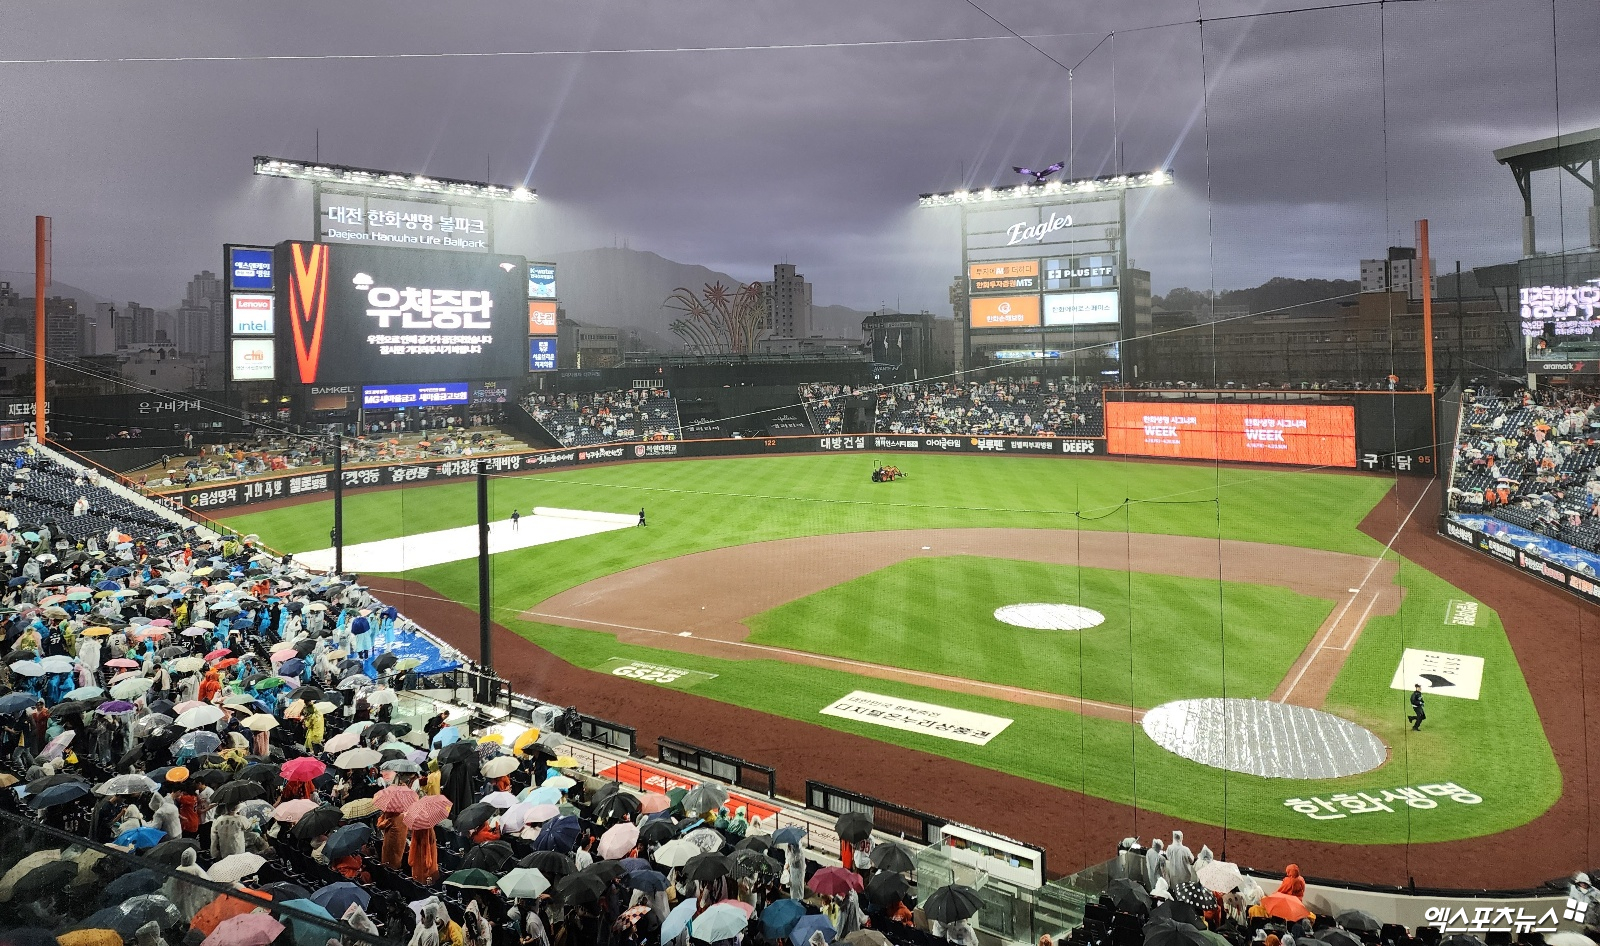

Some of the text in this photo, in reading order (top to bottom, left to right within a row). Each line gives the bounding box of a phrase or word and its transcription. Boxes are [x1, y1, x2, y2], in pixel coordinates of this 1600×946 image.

[328, 206, 485, 234] 대전 한화생명 볼파크
[1007, 212, 1072, 246] Eagles
[328, 229, 485, 249] Daejeon Hanwha Life Ballpark
[1064, 267, 1112, 277] PLUS ETF
[238, 299, 268, 308] Lenovo
[366, 287, 493, 329] 우천중단
[239, 320, 267, 331] intel
[1543, 362, 1574, 370] aramark
[311, 386, 354, 395] BAMKEL
[24, 420, 50, 437] GS5
[1144, 425, 1179, 437] WEEK
[1244, 429, 1284, 441] WEEK
[821, 437, 865, 450] 대방건설
[1062, 442, 1095, 454] DEEPS
[1418, 455, 1431, 464] 95
[199, 488, 238, 507] 음성명작
[612, 666, 681, 683] GS25
[834, 703, 992, 739] 디지털온누리상품권
[1283, 782, 1483, 820] 한화생명
